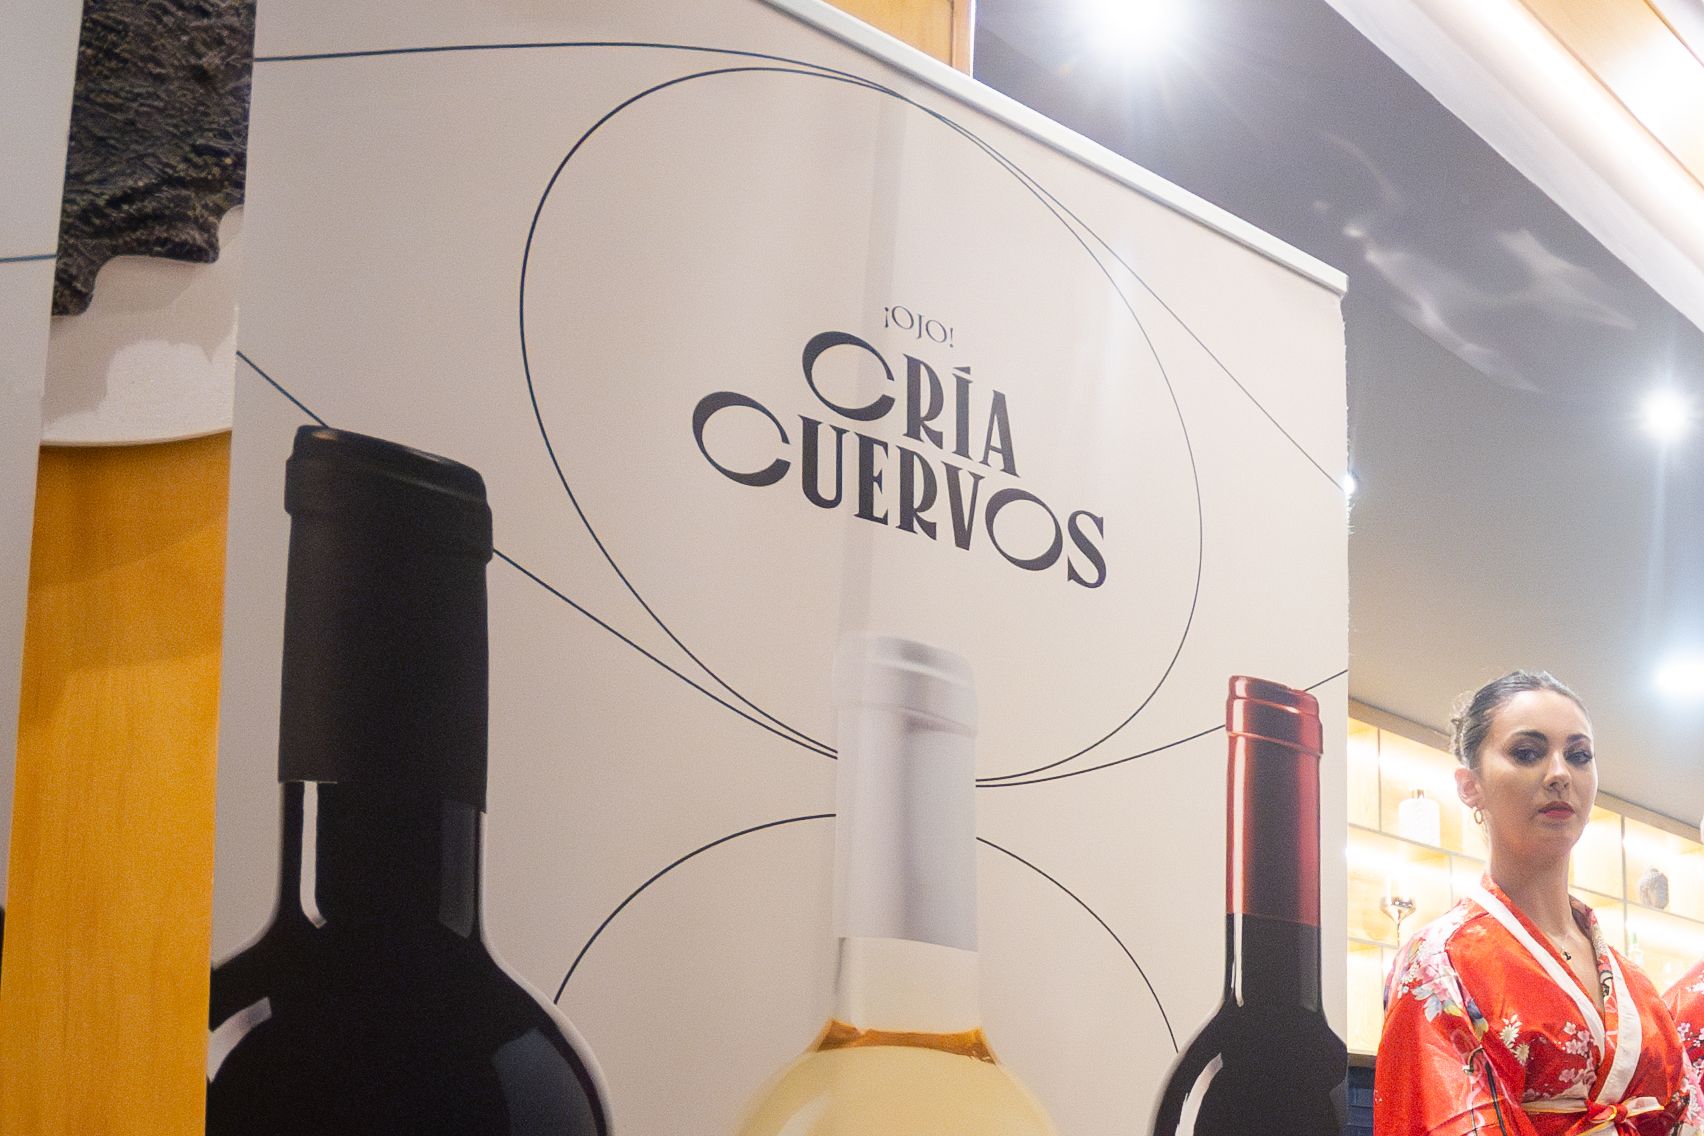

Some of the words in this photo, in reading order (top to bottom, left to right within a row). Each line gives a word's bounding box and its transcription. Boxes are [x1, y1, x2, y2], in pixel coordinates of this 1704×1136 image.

[884, 305, 955, 348] ¡OJO!
[802, 331, 1020, 478] CRÍA
[692, 391, 1107, 588] CUERVOS
